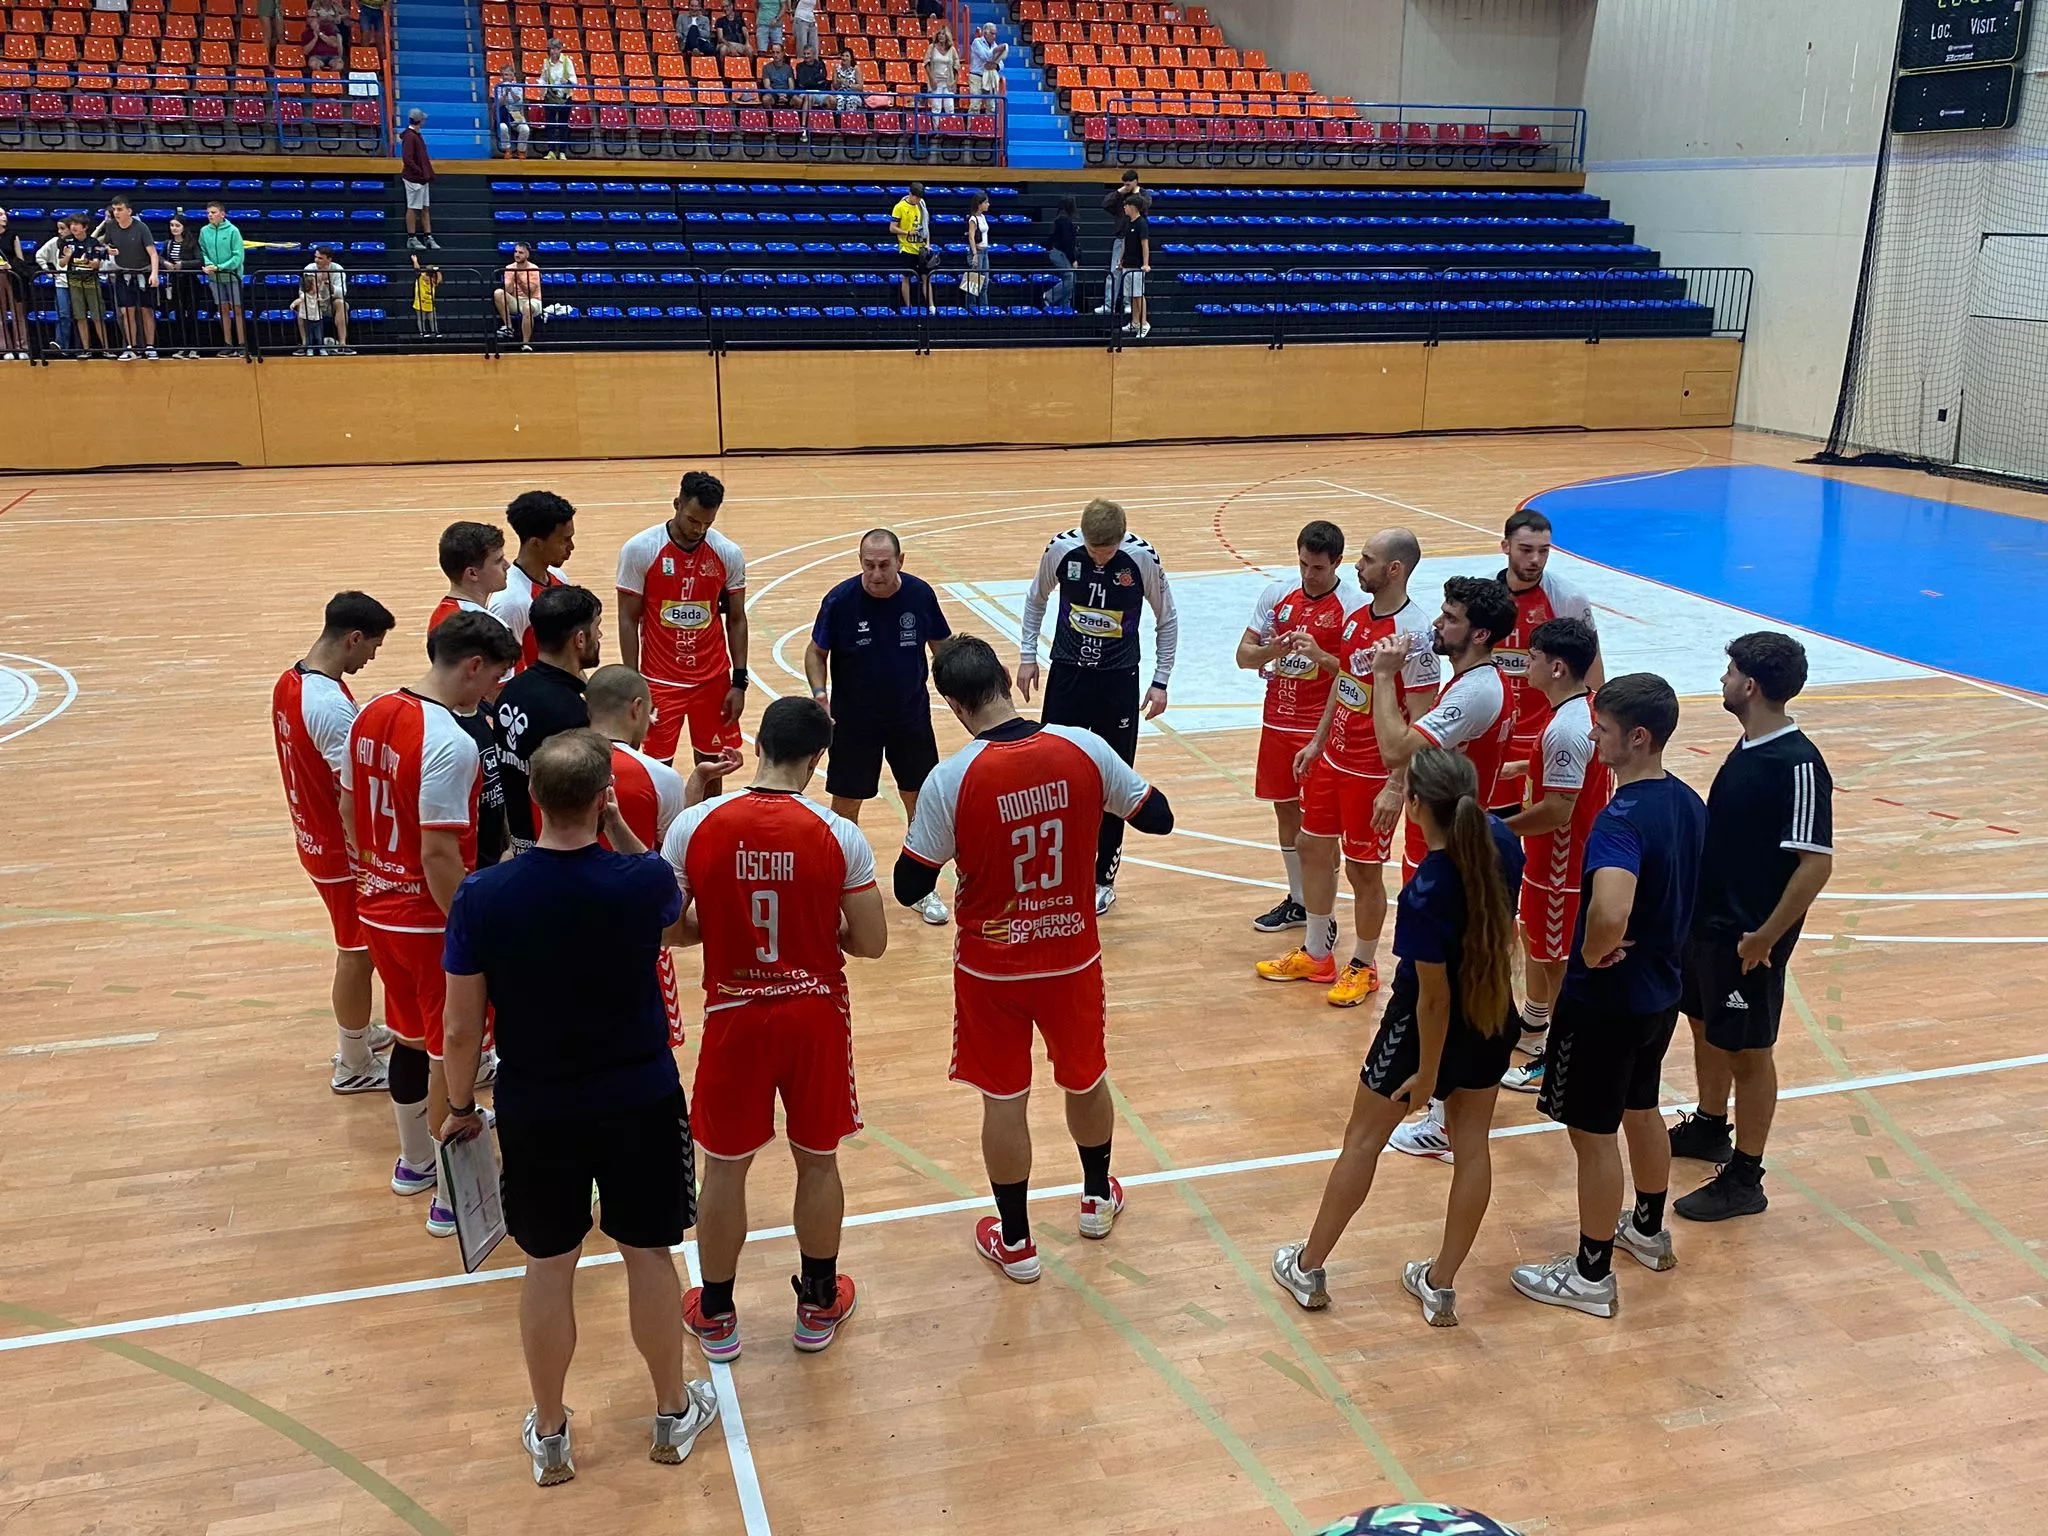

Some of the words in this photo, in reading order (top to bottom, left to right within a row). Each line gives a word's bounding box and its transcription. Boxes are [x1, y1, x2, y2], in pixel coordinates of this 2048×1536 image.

[1931, 23, 1953, 40] LOC.
[1971, 17, 1997, 35] VISIT.
[681, 577, 695, 600] 27
[1088, 582, 1106, 609] 74
[672, 609, 702, 620] Bada
[1078, 614, 1111, 629] Bada
[1080, 645, 1102, 660] es
[1280, 656, 1307, 670] Bada
[1338, 679, 1359, 701] Bada
[996, 779, 1069, 824] RODRIGO
[735, 840, 795, 881] ÓSCAR
[1011, 818, 1063, 893] 23
[1018, 895, 1074, 912] Huesca
[751, 889, 779, 963] 9
[1010, 911, 1082, 932] GOBIERNO
[1010, 931, 1029, 944] DE
[1032, 918, 1086, 941] ARAGON
[1725, 999, 1749, 1010] adidas
